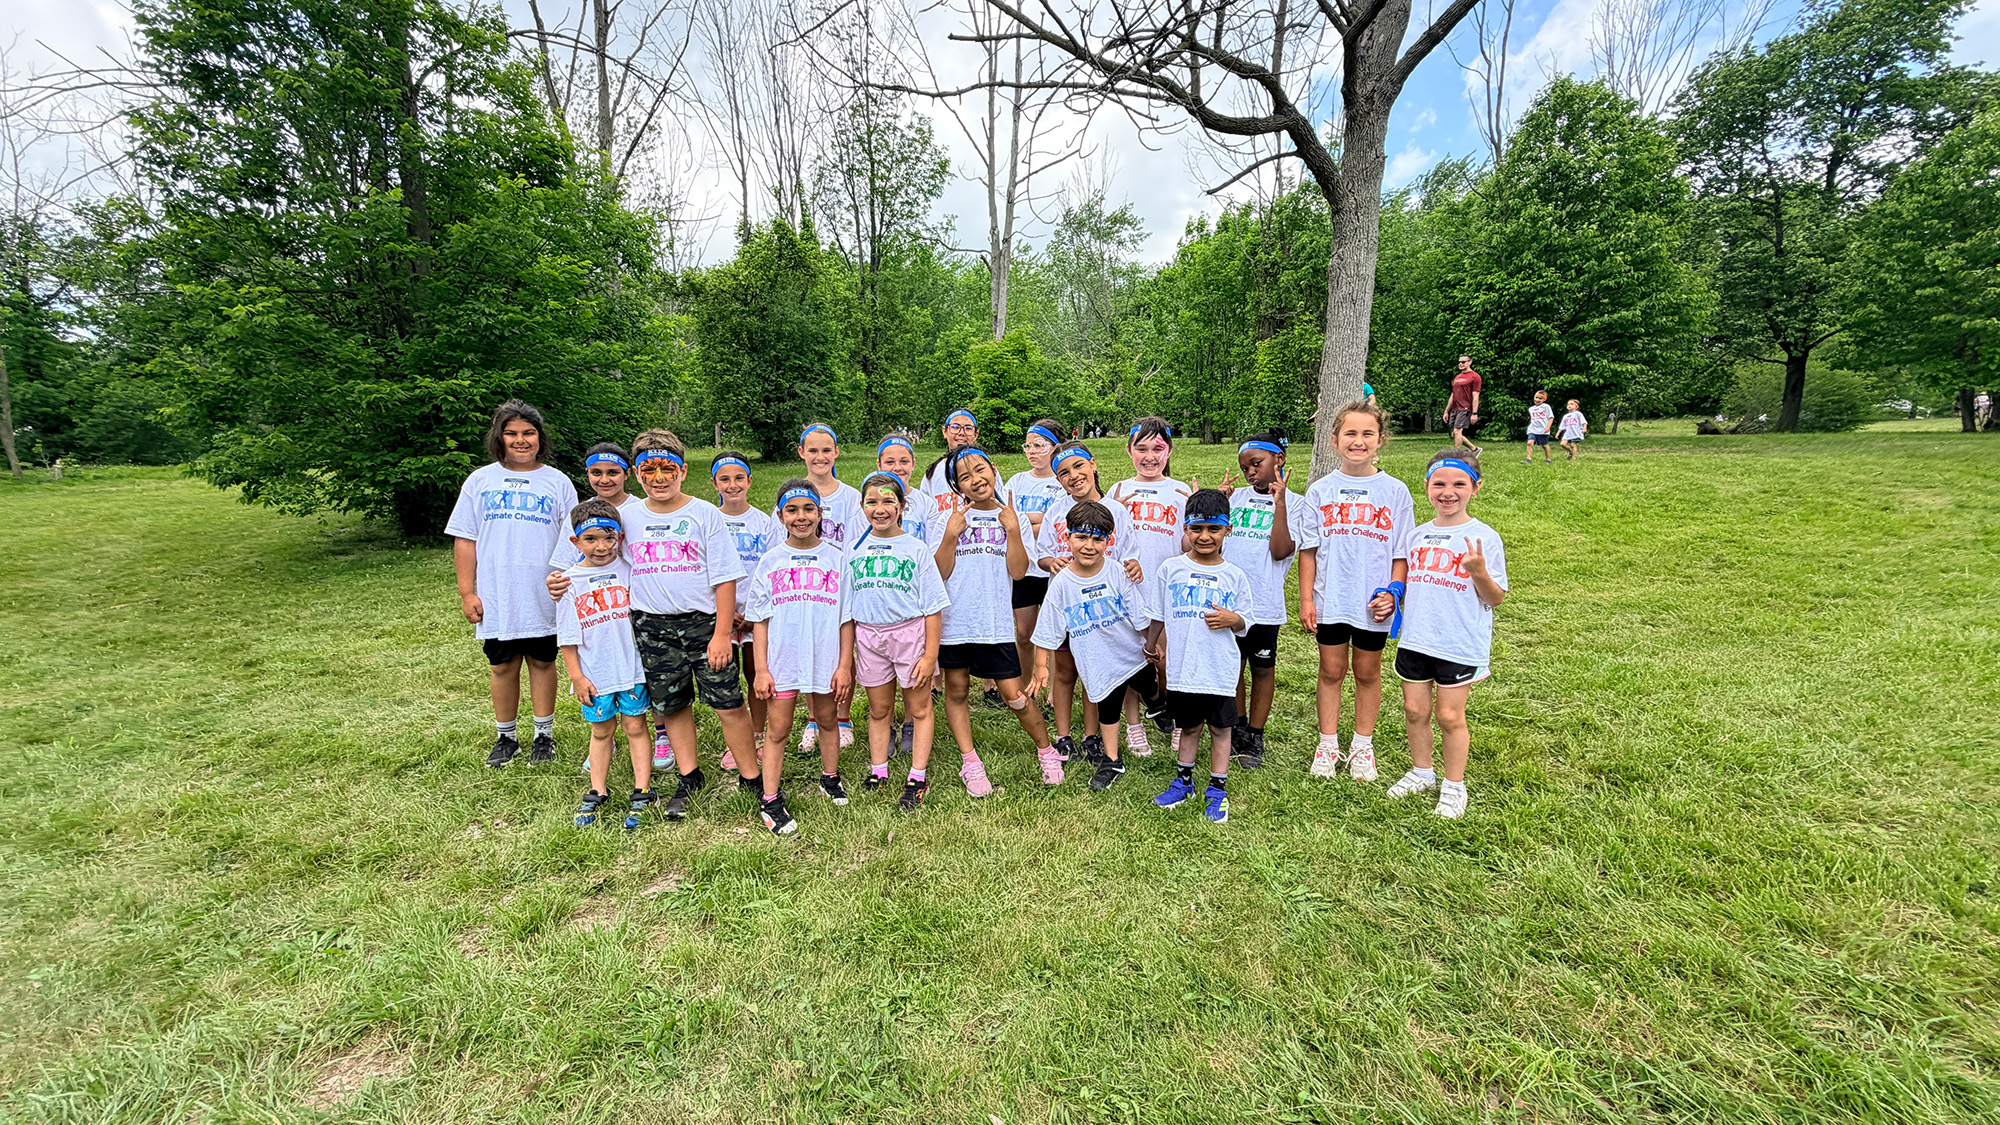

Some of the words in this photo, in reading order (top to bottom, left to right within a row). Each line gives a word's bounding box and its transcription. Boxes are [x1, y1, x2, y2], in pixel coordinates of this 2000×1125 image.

[481, 490, 554, 515] KIDS
[514, 512, 552, 525] Challenge
[1229, 507, 1274, 530] KID
[1320, 501, 1392, 531] KIDS
[957, 526, 1007, 546] KID
[1142, 523, 1175, 537] Challenge
[628, 540, 699, 565] KIDS
[730, 532, 767, 558] DS
[954, 547, 983, 557] ltimate
[985, 546, 1006, 557] Challe
[661, 564, 701, 574] Challenge
[849, 556, 916, 583] KIDS
[597, 580, 612, 588] 284
[768, 567, 840, 596] KIDS
[1196, 579, 1211, 587] 314
[1423, 574, 1467, 592] Challenge
[574, 585, 630, 620] KID
[802, 592, 838, 606] Challenge
[1088, 591, 1103, 600] 644
